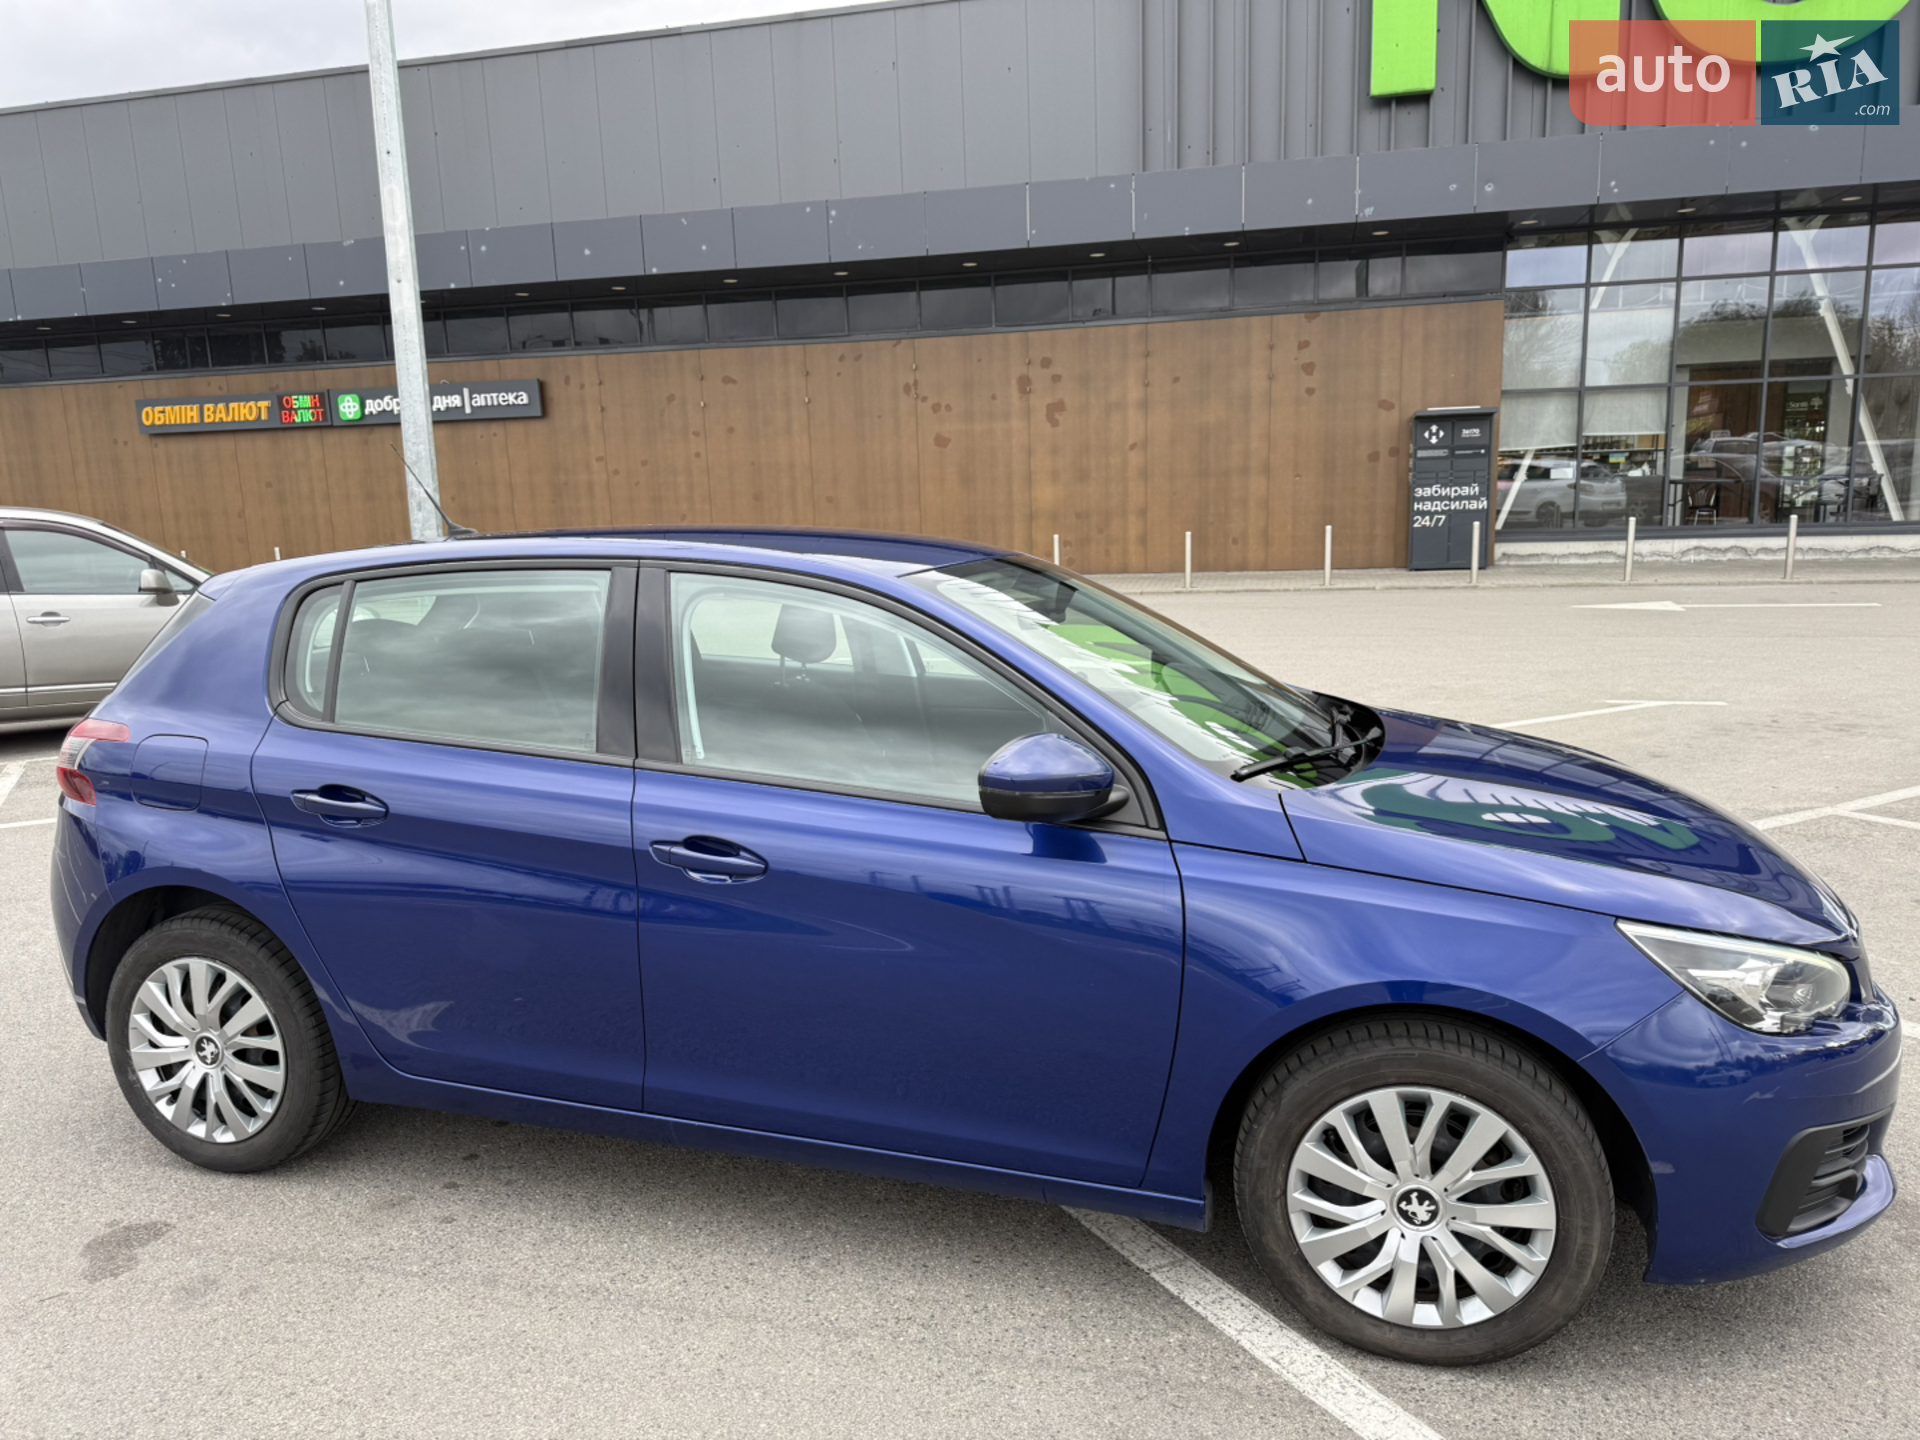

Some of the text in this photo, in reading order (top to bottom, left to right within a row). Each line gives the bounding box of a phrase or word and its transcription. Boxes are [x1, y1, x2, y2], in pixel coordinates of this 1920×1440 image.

[283, 394, 320, 409] ОБМІН
[432, 394, 462, 412] дня
[471, 391, 529, 406] аптека
[142, 400, 271, 426] ОБМІН ВАЛЮТ
[281, 409, 324, 424] ВАЛЮТ
[1414, 483, 1479, 499] забирай
[1413, 497, 1487, 512] надсилай
[1413, 515, 1446, 527] 24/7
